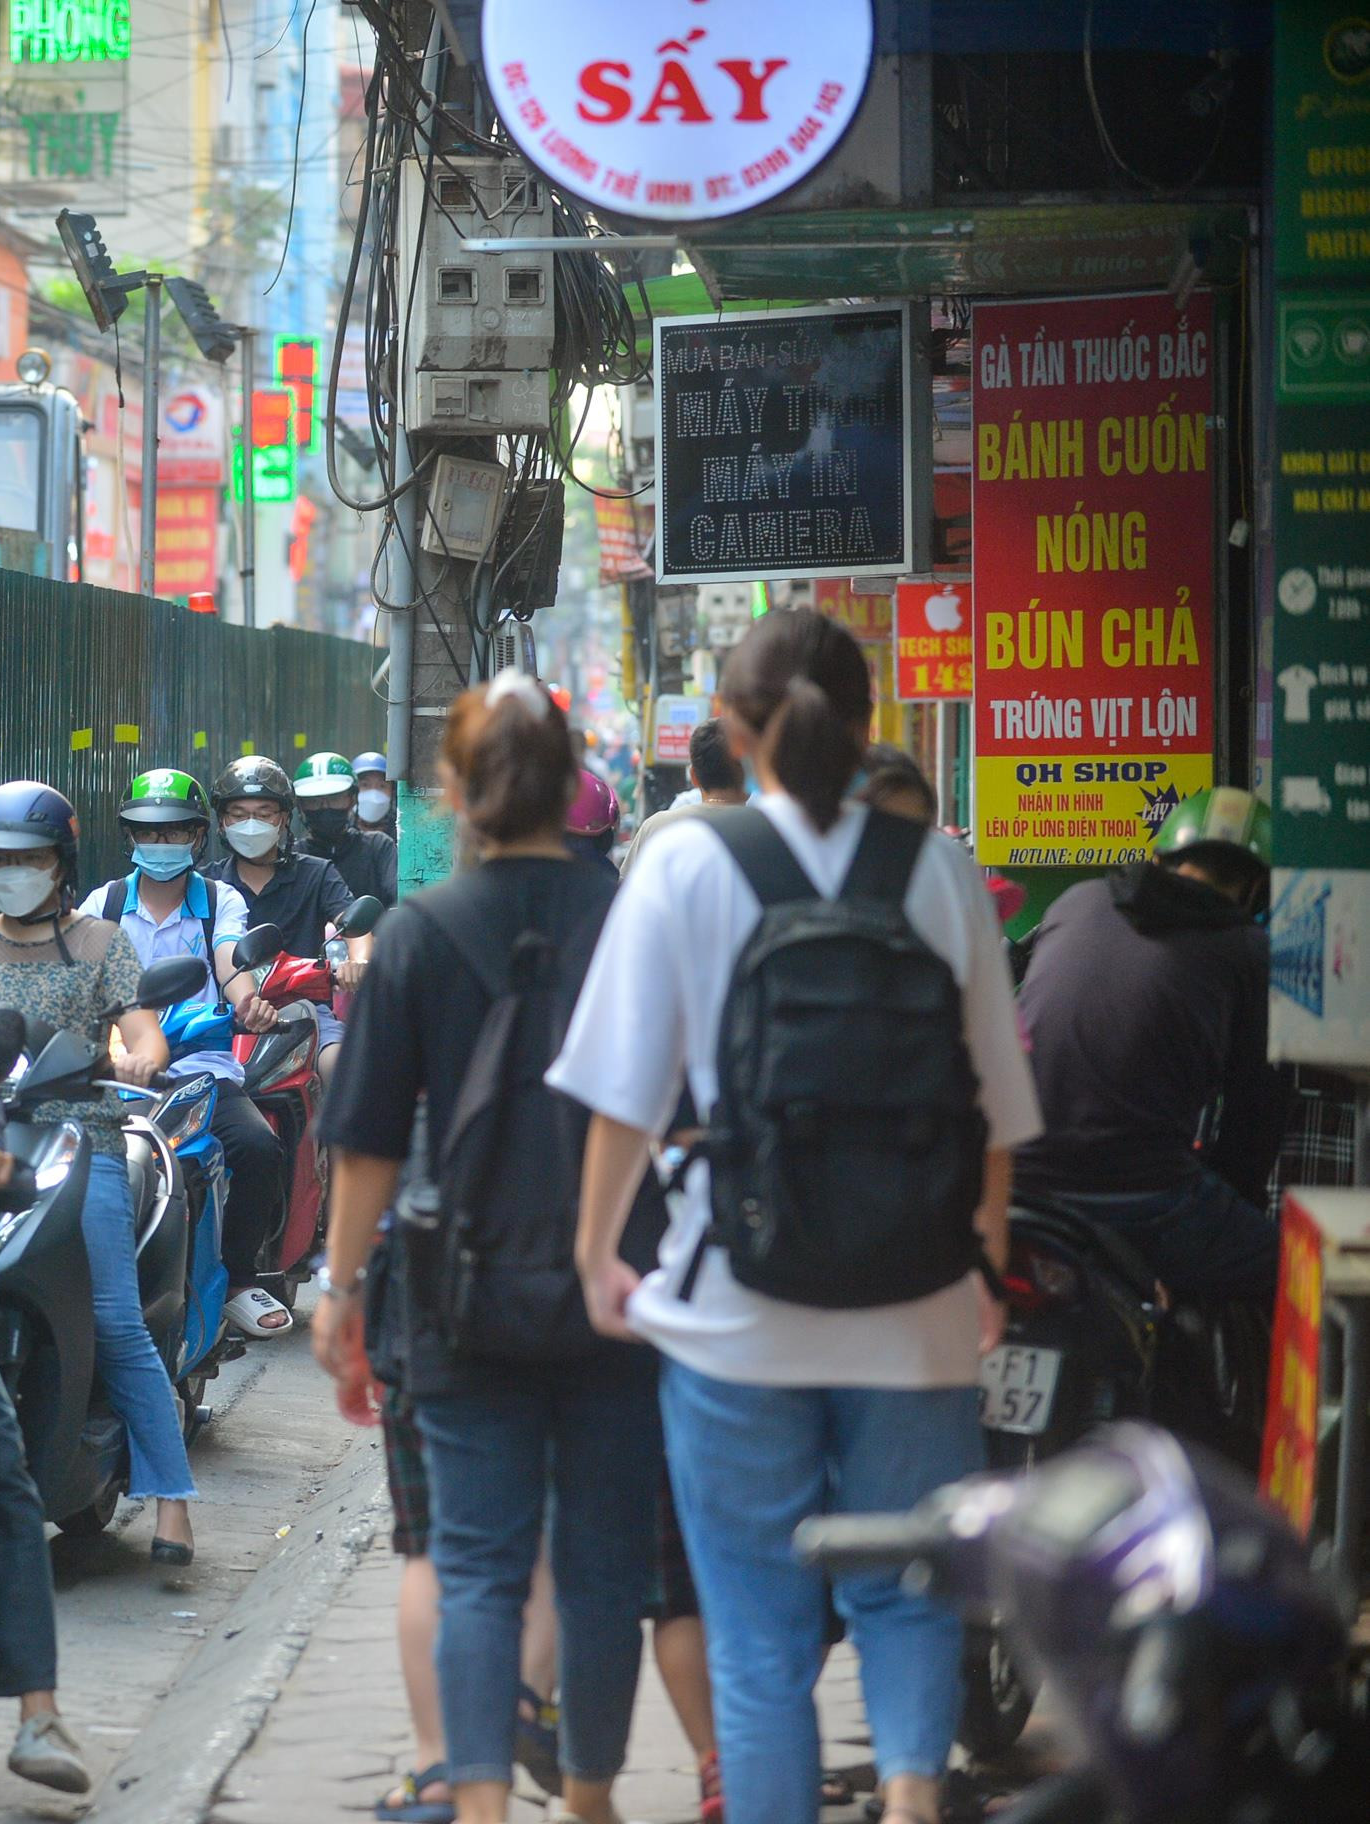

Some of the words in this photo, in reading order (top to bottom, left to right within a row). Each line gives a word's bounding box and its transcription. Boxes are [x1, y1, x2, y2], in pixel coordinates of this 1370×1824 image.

[576, 28, 789, 124] SẤY
[981, 334, 1013, 390] GÀ
[1072, 319, 1151, 385] THUỐC
[1158, 314, 1207, 379] BẮC
[676, 377, 769, 438] MÁY
[978, 409, 1084, 481] BÁNH
[1097, 392, 1207, 477] CUỐN
[703, 442, 797, 503] MÁY
[810, 448, 858, 498] IN
[689, 506, 876, 561] CAMERA
[1037, 501, 1147, 573] NÓNG
[898, 637, 942, 658] TECH
[986, 598, 1084, 670] BÚN
[1101, 586, 1200, 668] CHẢ
[990, 691, 1082, 740] TRỨNG
[1091, 697, 1133, 747] VỊT
[1141, 688, 1198, 747] LỘN
[1016, 763, 1063, 787] QH
[1074, 761, 1168, 783] SHOP
[1017, 791, 1053, 816] NHẬN
[1056, 795, 1070, 812] IN
[1073, 790, 1104, 812] HÌNH
[986, 816, 1009, 838] LÊN
[1013, 814, 1029, 838] ỐP
[1032, 819, 1065, 838] LƯNG
[1068, 816, 1097, 842] ĐIỆN
[1101, 819, 1138, 842] THOẠI
[1008, 848, 1071, 865] HOTLINE:
